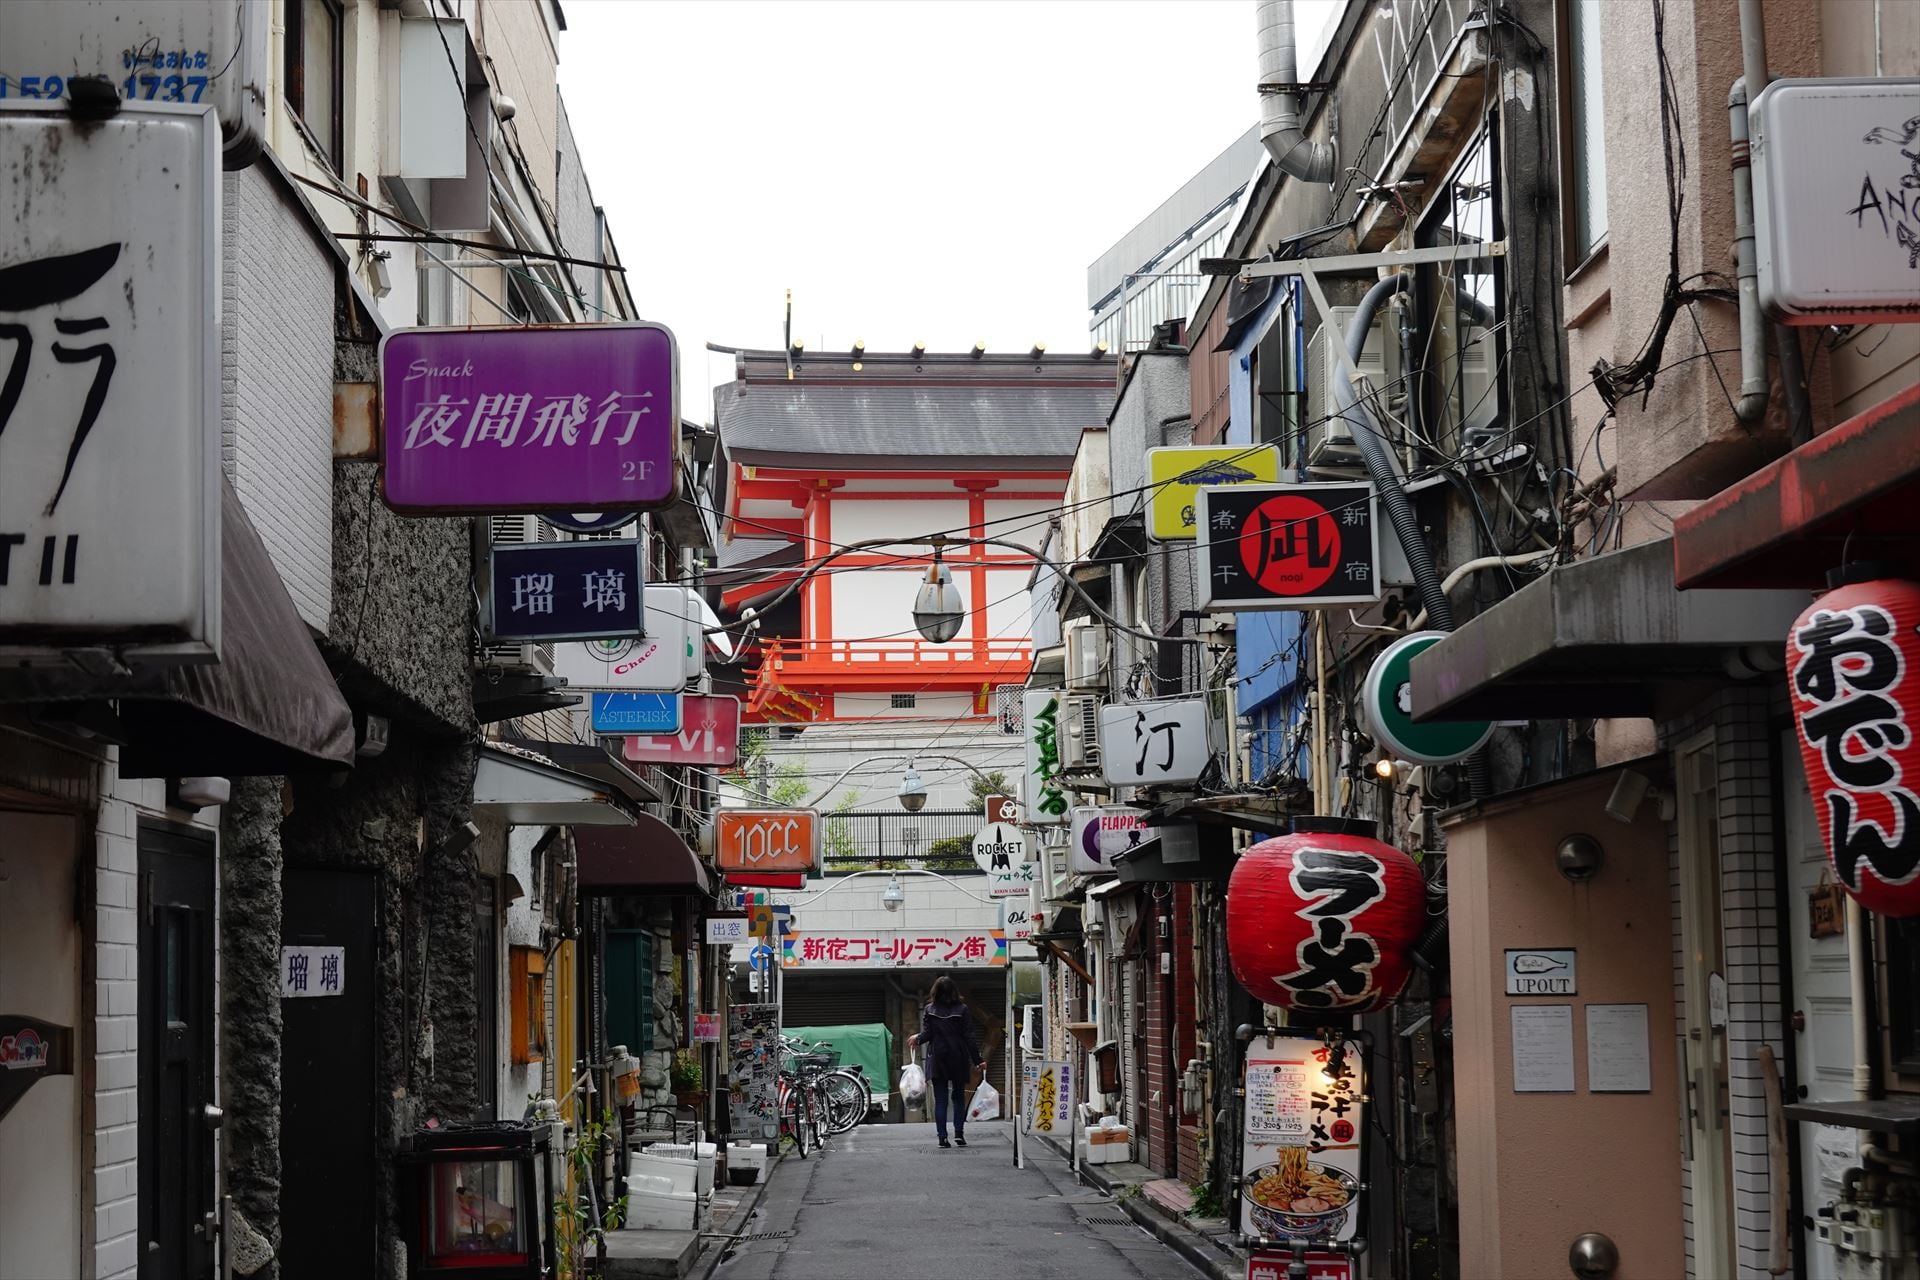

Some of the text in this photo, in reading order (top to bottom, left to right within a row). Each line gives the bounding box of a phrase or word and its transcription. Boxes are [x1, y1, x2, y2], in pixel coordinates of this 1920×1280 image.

[404, 359, 473, 381] Snack
[403, 391, 653, 450] 夜間飛行
[622, 461, 655, 481] 2F
[1255, 508, 1332, 584] 凪
[511, 569, 626, 616] 瑠璃
[614, 644, 657, 675] Chaco
[600, 711, 671, 724] ASTERISK
[1135, 711, 1181, 776] 汀
[1794, 605, 1920, 892] おでん
[977, 841, 1022, 855] ROCKET
[713, 922, 741, 936] 出窓
[1275, 847, 1386, 1013] ラーメン
[803, 936, 986, 960] 新宿ゴールデン街
[288, 954, 339, 991] 瑠璃
[1516, 978, 1569, 993] UPOUT
[1310, 1092, 1330, 1153] ラーメン
